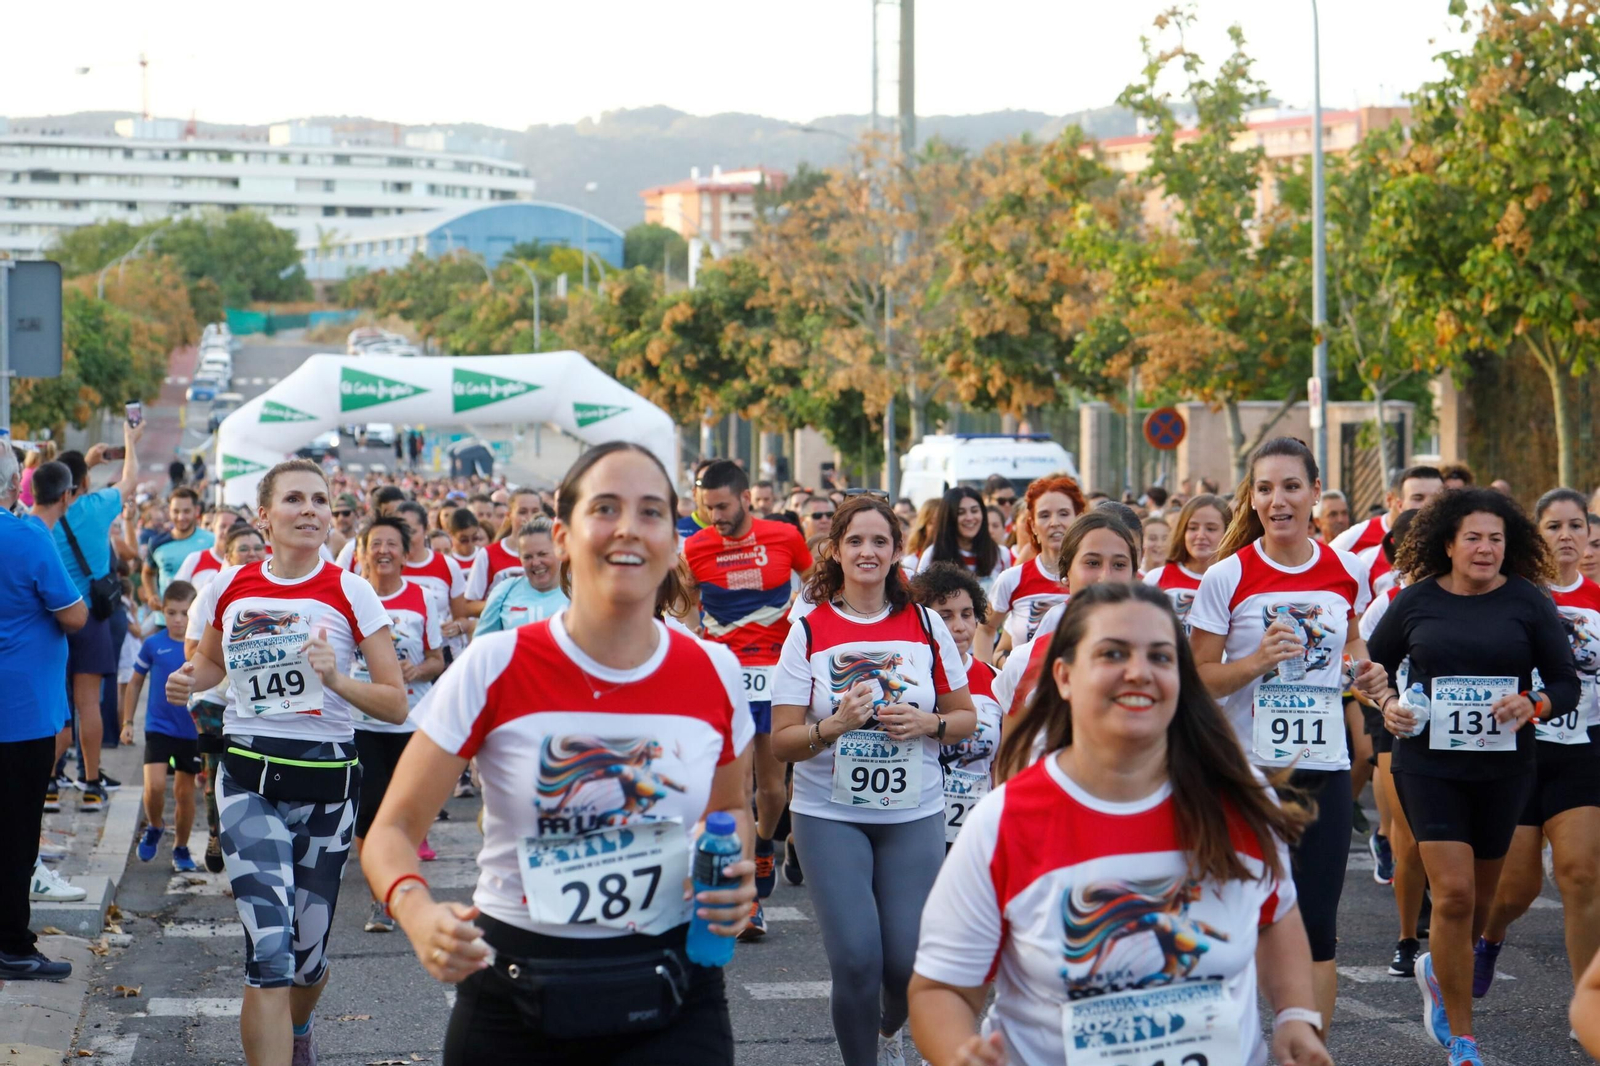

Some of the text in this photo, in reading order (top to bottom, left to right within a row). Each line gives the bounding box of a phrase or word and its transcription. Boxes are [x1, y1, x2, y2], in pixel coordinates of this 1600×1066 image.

[716, 552, 757, 562] MOUNTAIN
[228, 650, 258, 661] 2024
[248, 670, 305, 702] 149
[1272, 718, 1326, 744] 911
[1448, 710, 1501, 736] 131
[841, 741, 874, 749] 2024
[851, 766, 906, 793] 903
[561, 865, 662, 925] 287
[1072, 1016, 1135, 1034] 2024
